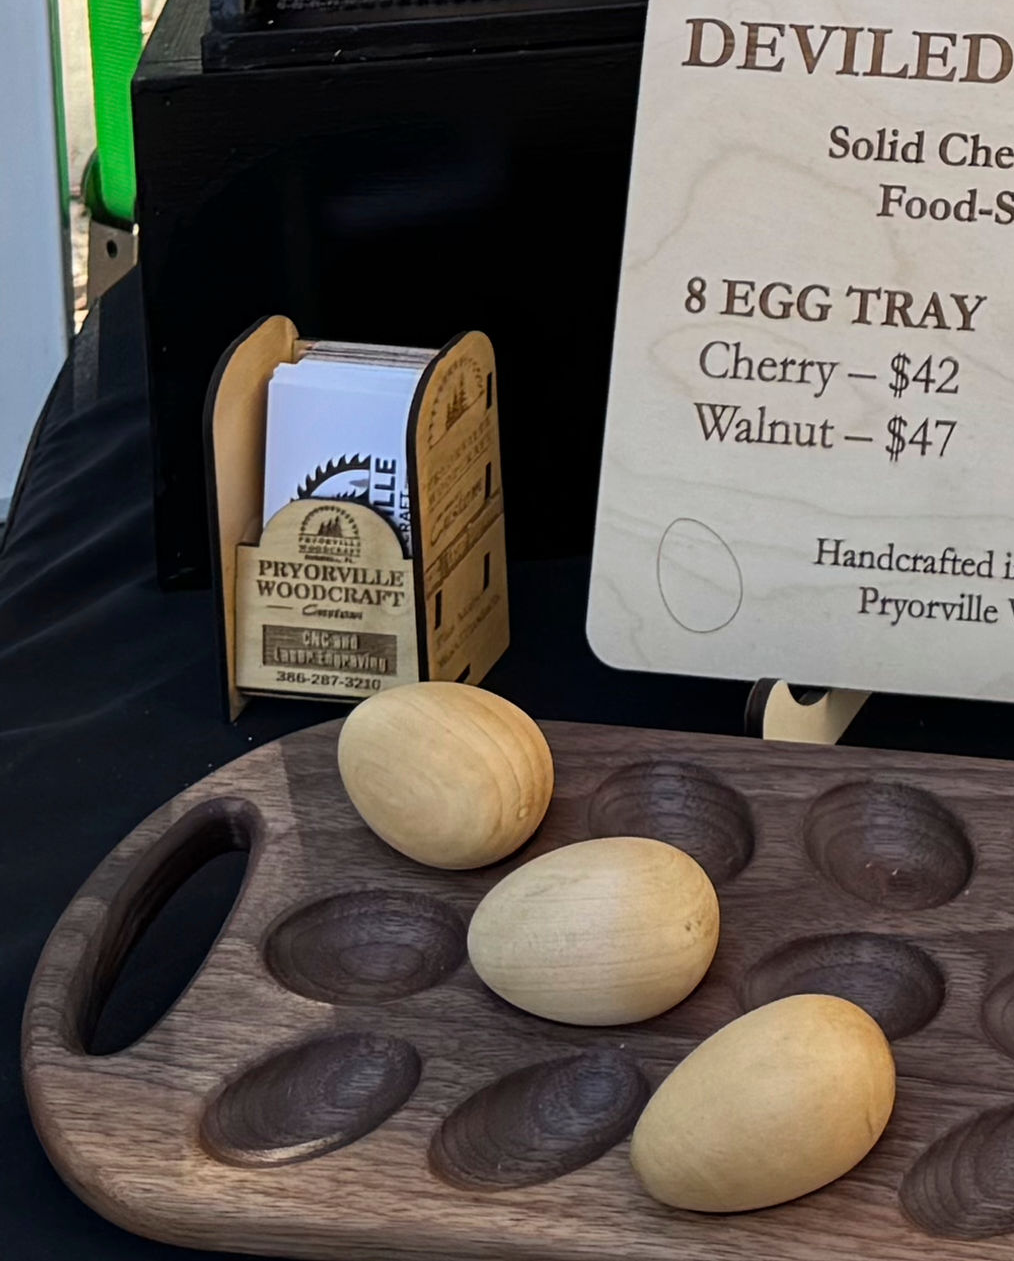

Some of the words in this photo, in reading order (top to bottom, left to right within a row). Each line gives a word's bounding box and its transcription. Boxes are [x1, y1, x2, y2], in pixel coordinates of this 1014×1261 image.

[680, 17, 1014, 85] DEVILED
[828, 124, 926, 165] Solid
[684, 276, 707, 315] 8
[718, 278, 833, 323] EGG
[844, 285, 988, 333] TRAY
[698, 340, 841, 399] Cherry
[888, 351, 960, 399] $42
[692, 401, 835, 450] Walnut
[884, 414, 958, 463] $47
[258, 559, 405, 587] PRYORVILLE
[812, 537, 995, 580] Handcrafted
[256, 579, 405, 607] WOODCRAFT
[857, 586, 999, 627] Pryorville
[276, 670, 382, 691] 386-287-3210
